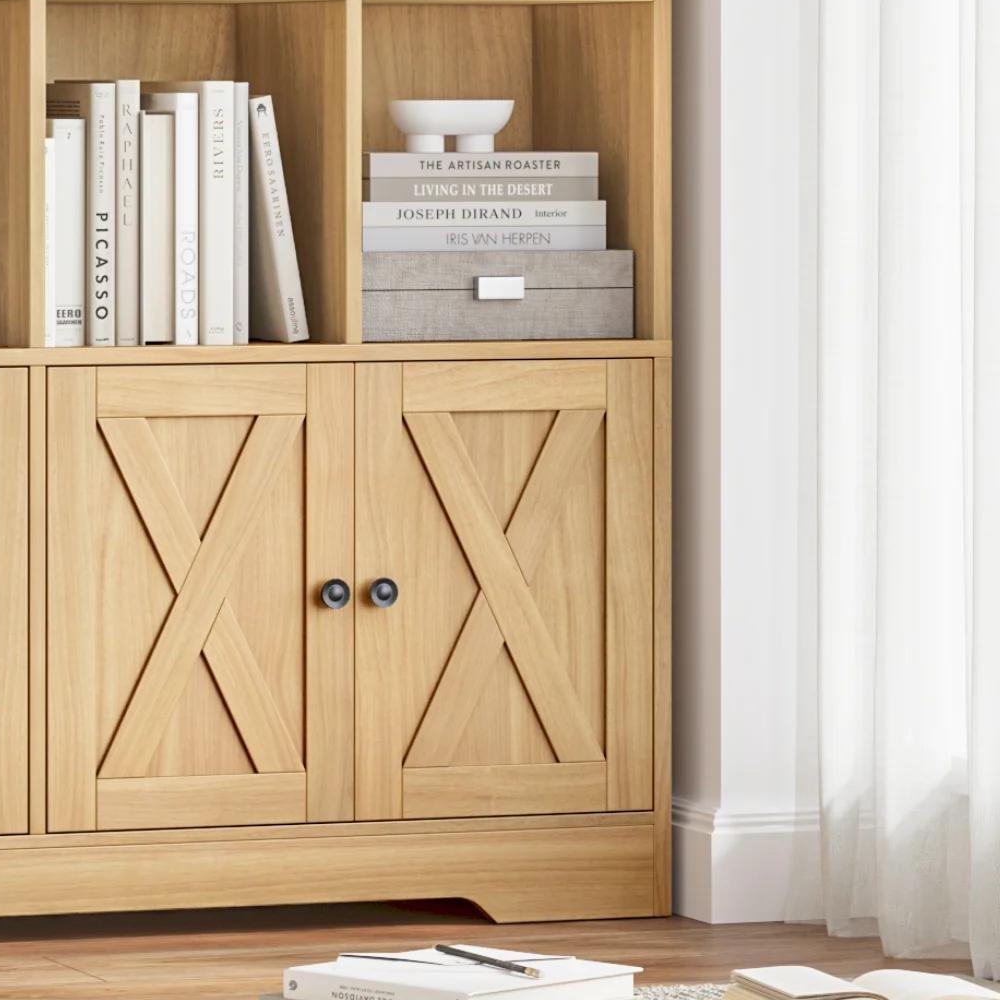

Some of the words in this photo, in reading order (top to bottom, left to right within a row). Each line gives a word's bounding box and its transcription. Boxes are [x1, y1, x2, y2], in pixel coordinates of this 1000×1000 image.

[212, 109, 224, 179] RIVERS
[261, 133, 276, 167] EERO
[122, 104, 133, 226] RAPHAEL
[420, 160, 443, 170] THE
[448, 160, 501, 170] ARTISAN
[505, 160, 561, 170] ROASTER
[267, 170, 286, 239] SAARINEN
[413, 184, 459, 197] LIVING
[462, 184, 476, 197] IN
[480, 184, 503, 196] THE
[507, 184, 553, 196] DESERT
[395, 208, 455, 220] JOSEPH
[462, 208, 522, 219] DIRAND
[535, 209, 567, 218] Interior
[446, 233, 468, 245] IRIS
[473, 233, 497, 245] VAN
[502, 232, 551, 245] HERPEN
[95, 212, 109, 320] PICASSO
[180, 231, 197, 320] ROADS
[56, 309, 82, 318] EERO
[286, 297, 300, 335] assouline
